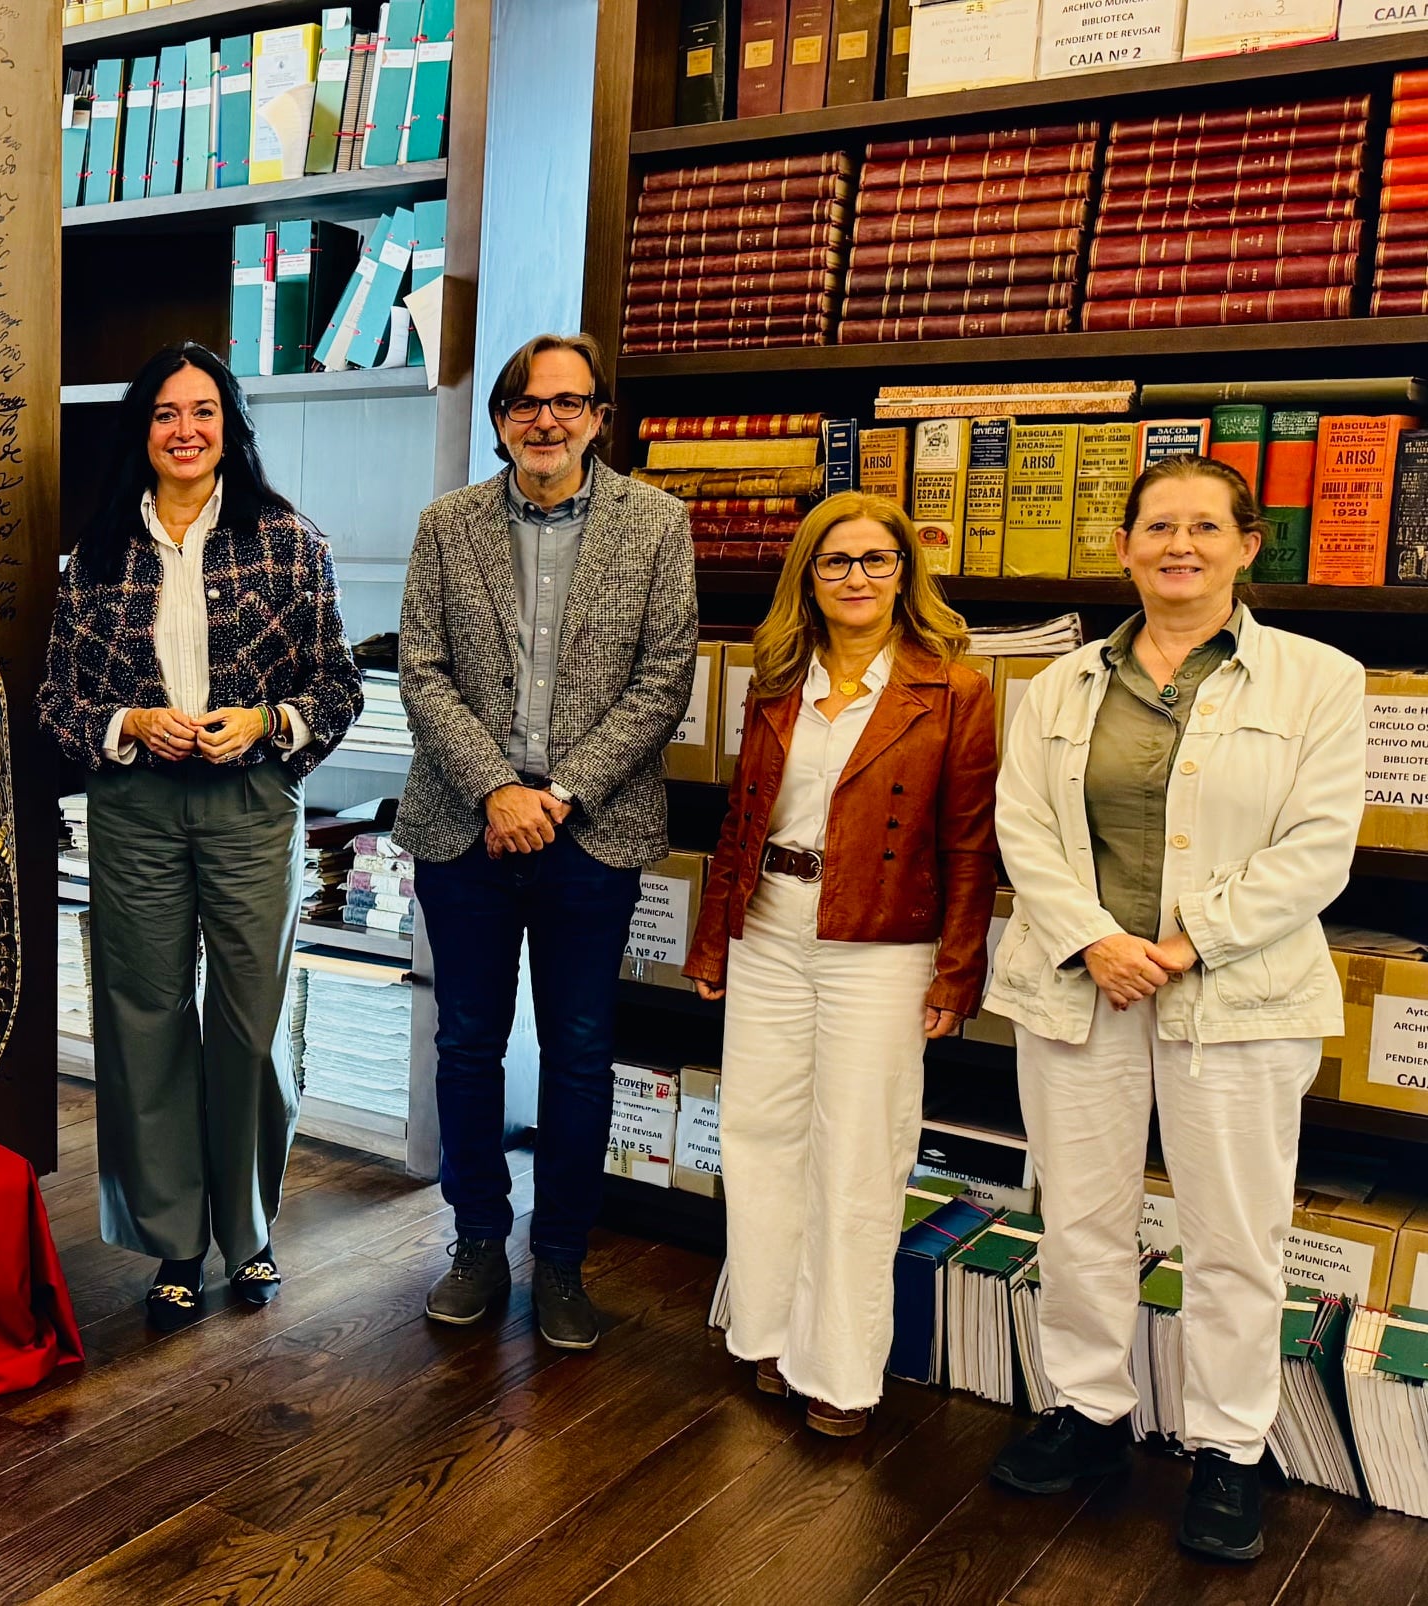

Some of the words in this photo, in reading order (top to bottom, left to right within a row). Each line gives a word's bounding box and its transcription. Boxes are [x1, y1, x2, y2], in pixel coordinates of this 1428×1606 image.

[1062, 0, 1102, 14] ARCHIVO
[1374, 5, 1417, 21] CAJA
[1081, 12, 1134, 27] BIBLIOTECA
[1055, 32, 1104, 47] PENDIENTE
[1106, 30, 1119, 40] DE
[1120, 26, 1161, 38] REVISAR
[1069, 51, 1103, 67] CAJA
[1108, 48, 1128, 64] Nº
[1132, 47, 1142, 60] 2
[1330, 435, 1364, 443] ARCAS
[863, 454, 892, 469] ARISÓ
[1021, 453, 1056, 469] ARISÓ
[1336, 448, 1376, 465] ARISÓ
[917, 488, 951, 499] ESPAÑA
[969, 487, 1002, 498] ESPAÑA
[1332, 509, 1368, 517] 1928
[1373, 705, 1401, 714] Ayto.
[1404, 706, 1417, 714] de
[1369, 721, 1414, 731] CIRCULO
[1367, 738, 1407, 747] RCHIVO
[1383, 755, 1428, 765] BIBLIOTE
[1365, 771, 1409, 781] NDIENTE
[1412, 774, 1426, 782] DE
[1364, 789, 1405, 804] CAJA
[642, 882, 669, 892] HUESCA
[635, 906, 674, 919] MUNICIPAL
[647, 934, 676, 945] REVISAR
[636, 947, 650, 958] Nº
[653, 950, 667, 961] 47
[1394, 1022, 1428, 1033] ARCHI
[1386, 1053, 1428, 1066] PENDIEN
[613, 1077, 654, 1092] SCOVERY
[1397, 1074, 1428, 1089] CAJ
[693, 1118, 719, 1130] ARCHIV
[622, 1124, 631, 1133] DE
[632, 1127, 663, 1140] REVISAR
[622, 1139, 636, 1149] Nº
[638, 1143, 653, 1155] 55
[687, 1142, 721, 1156] PENDIENT
[695, 1159, 722, 1174] CAJA
[967, 1189, 994, 1200] OTECA
[1288, 1236, 1301, 1244] de
[1303, 1239, 1343, 1255] HUESCA
[1295, 1253, 1351, 1273] MUNICIPAL
[1284, 1266, 1325, 1282] LIOTECA
